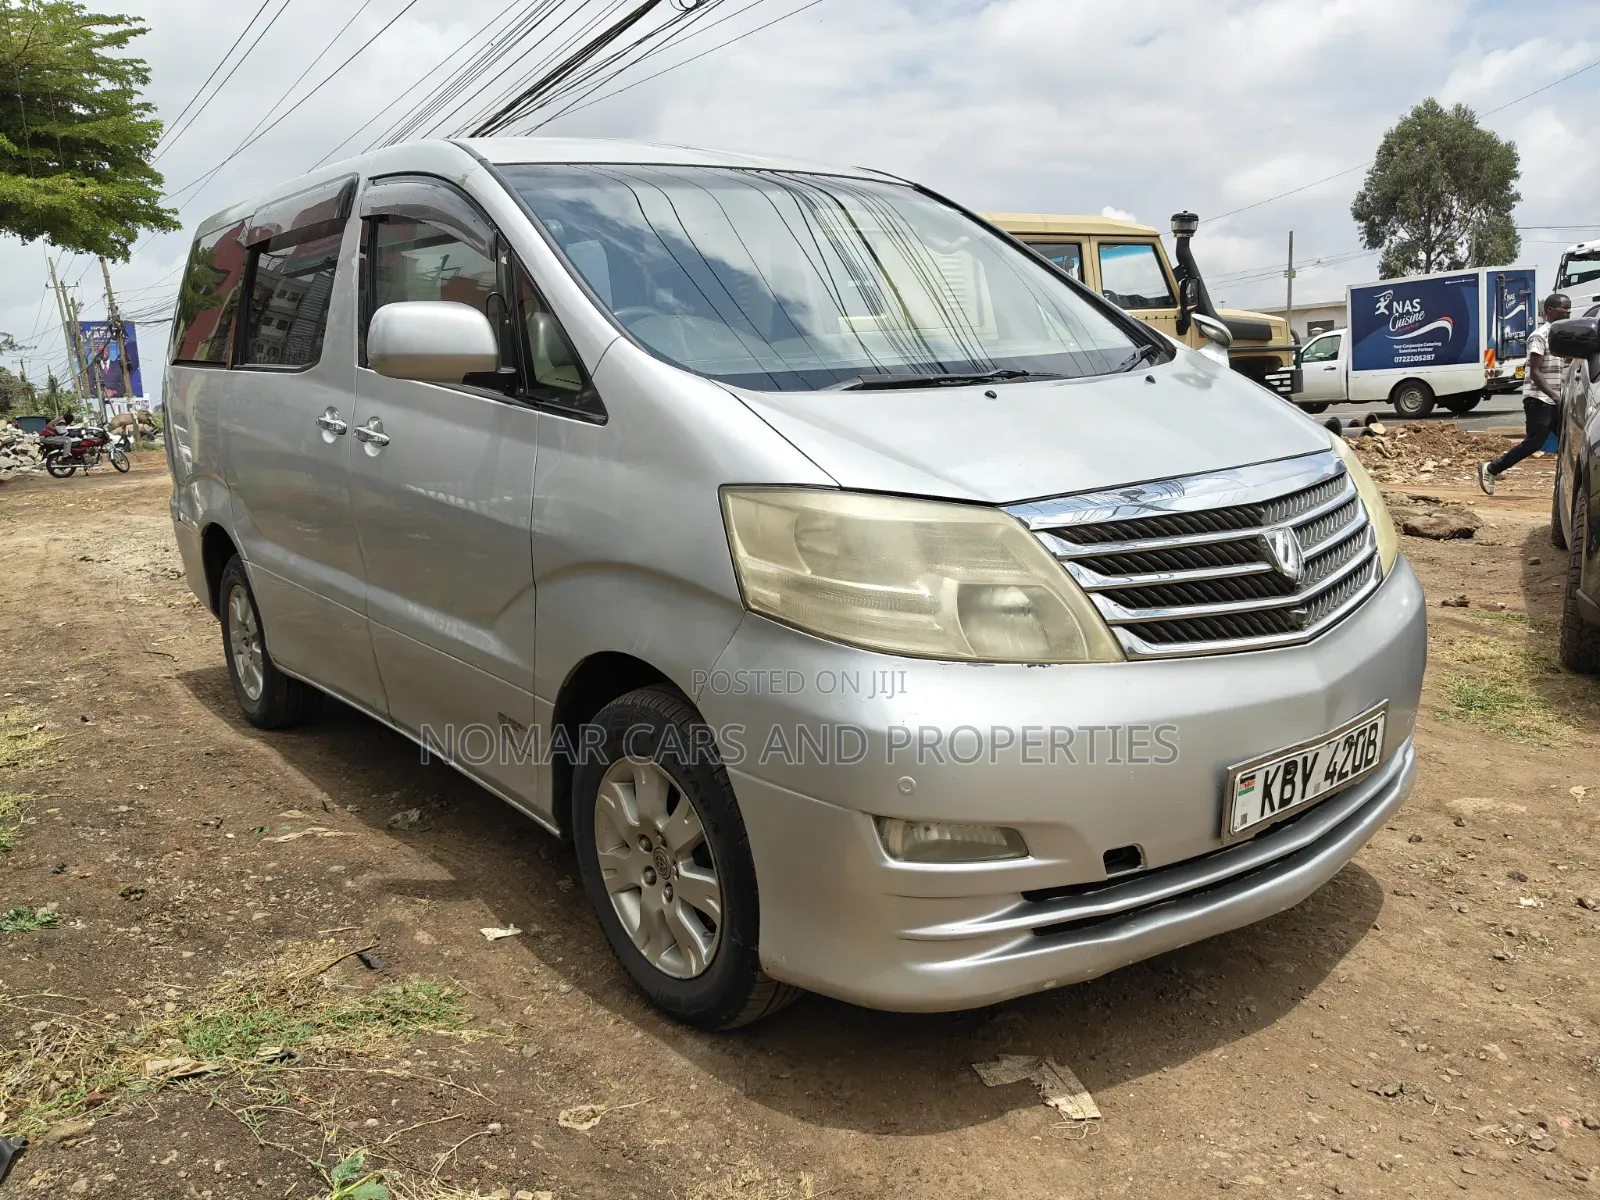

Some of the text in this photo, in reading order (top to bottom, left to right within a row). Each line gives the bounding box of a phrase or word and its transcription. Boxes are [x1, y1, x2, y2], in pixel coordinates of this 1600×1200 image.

[1393, 299, 1421, 313] NAS
[1389, 311, 1425, 332] Cuisine
[1394, 354, 1436, 363] 0722205287
[1260, 722, 1379, 817] KBY 420B
